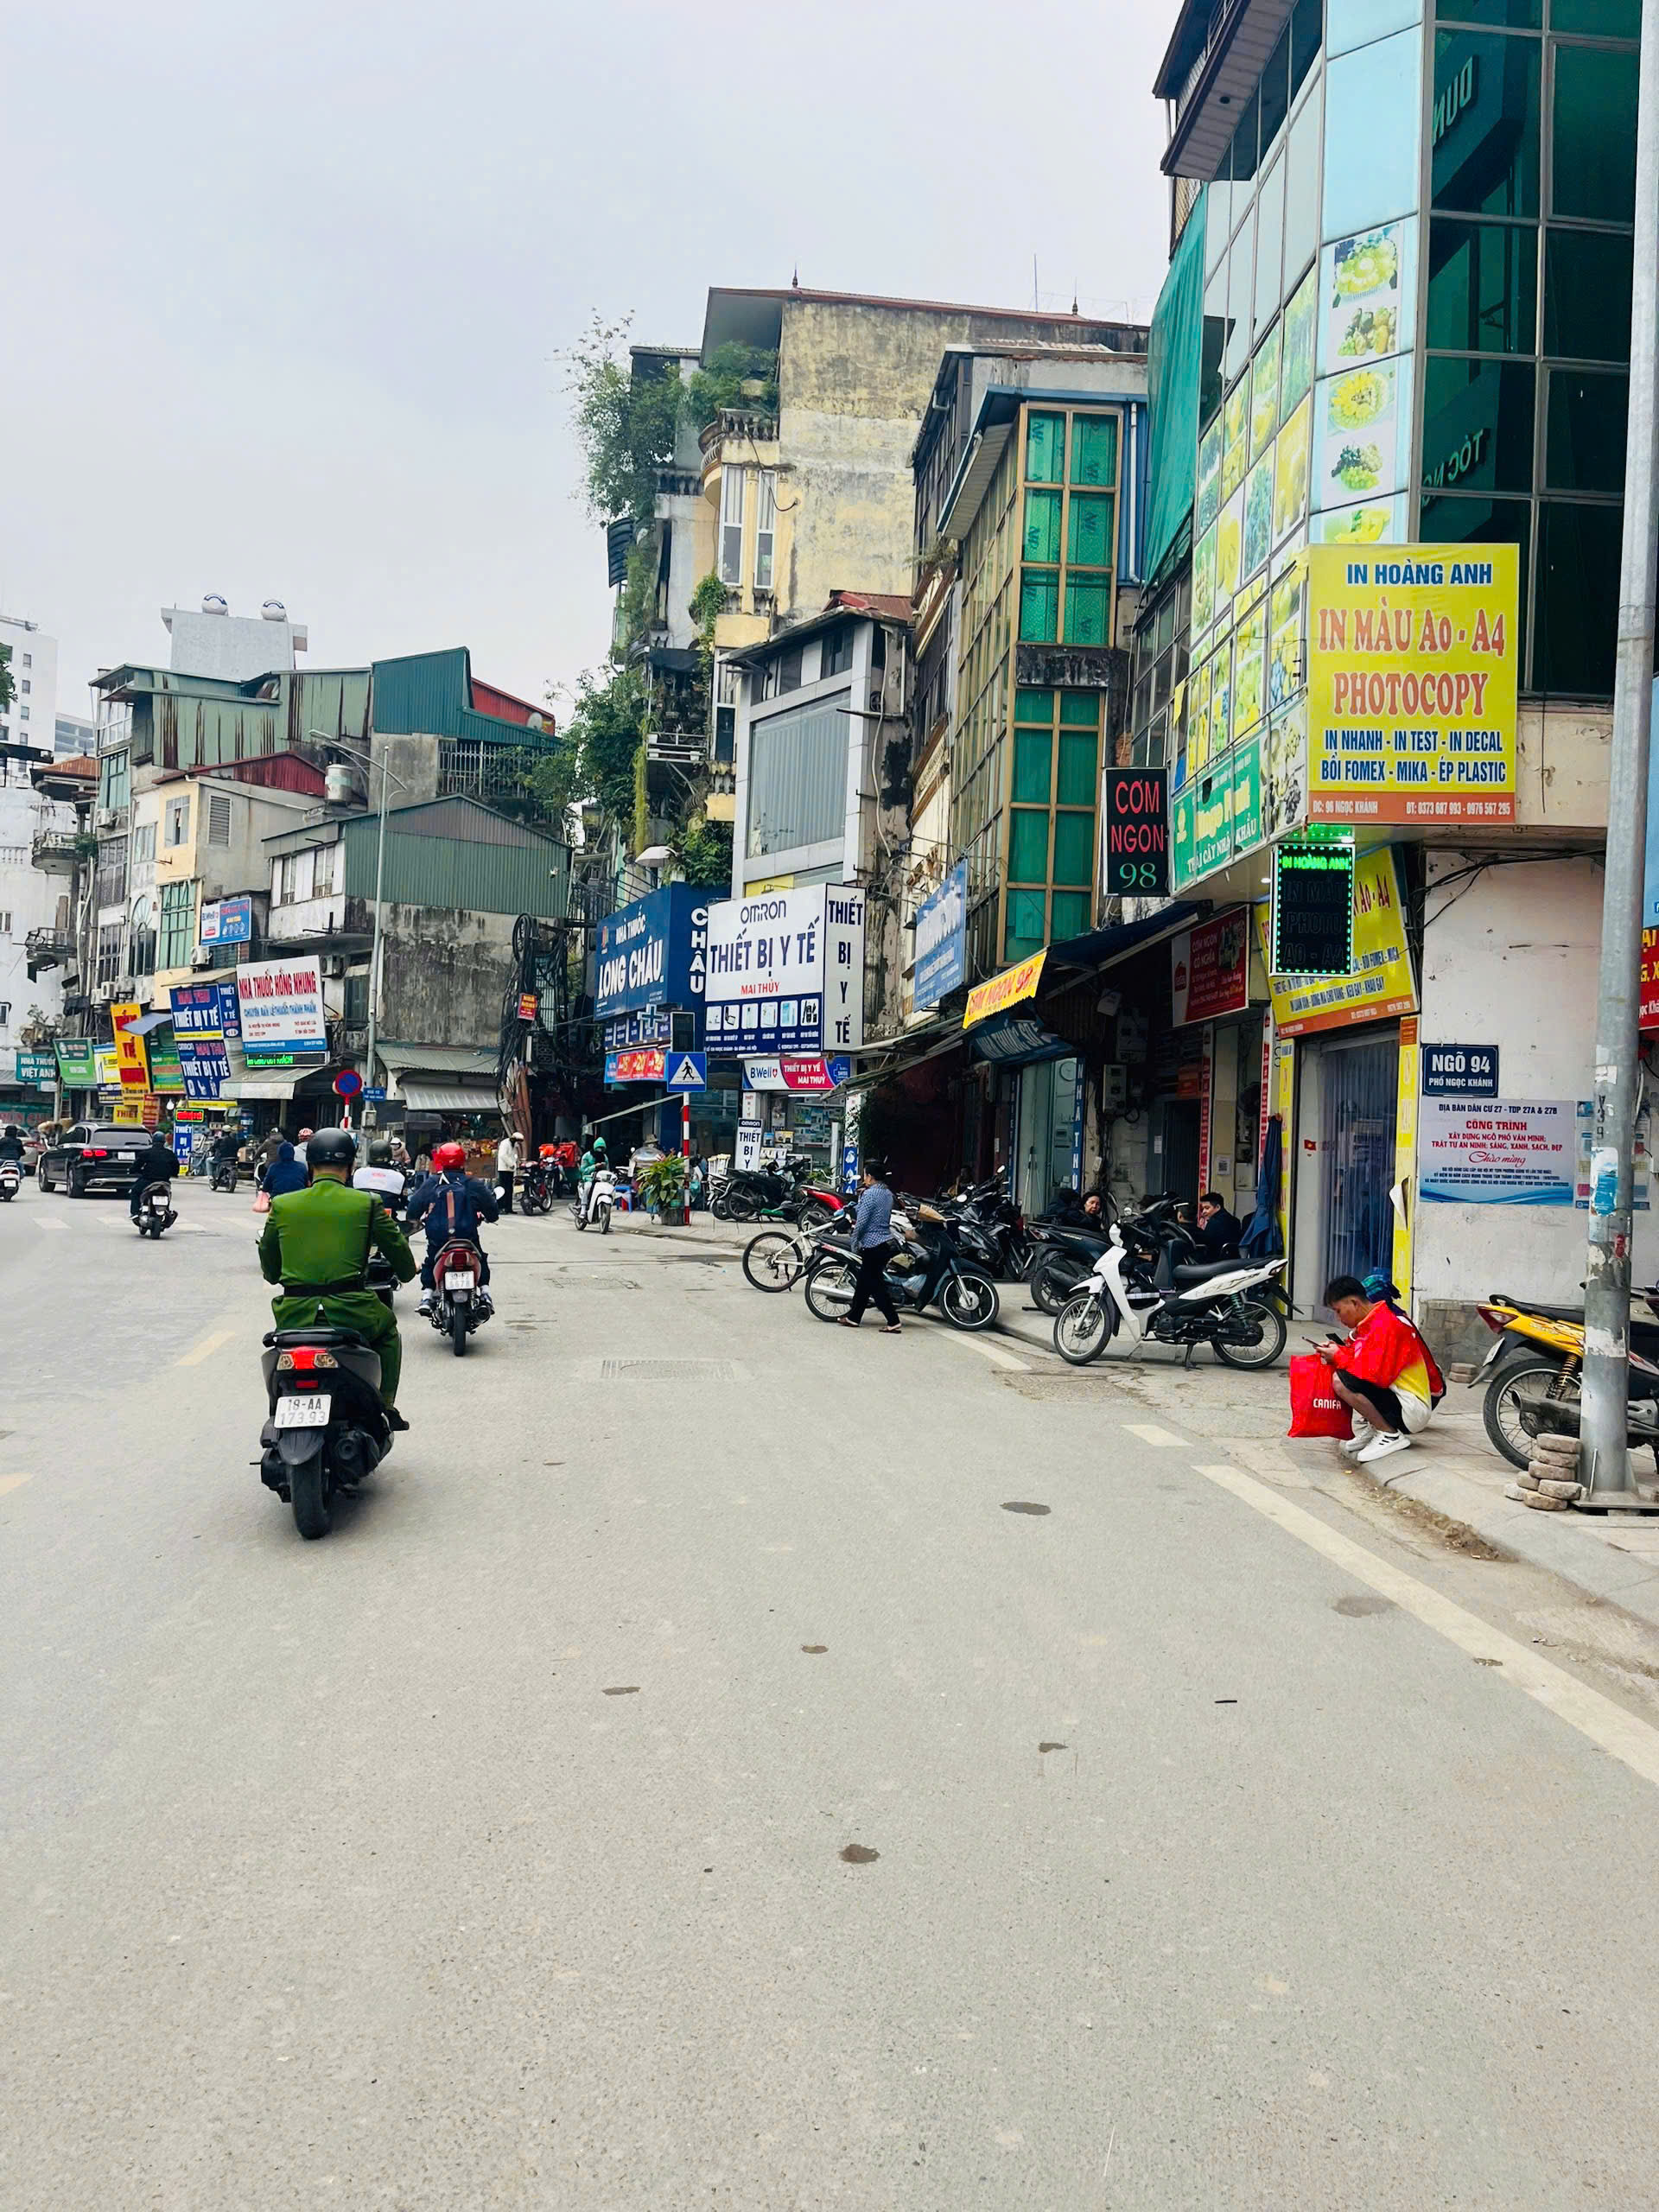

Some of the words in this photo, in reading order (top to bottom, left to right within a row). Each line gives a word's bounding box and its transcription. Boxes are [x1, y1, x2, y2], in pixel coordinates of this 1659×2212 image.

[1347, 563, 1368, 584] IN
[1375, 559, 1443, 584] HOÀNG
[1450, 563, 1492, 584] ANH
[1319, 608, 1347, 651] IN
[1354, 596, 1412, 652] MÀU
[1471, 608, 1504, 657] A4
[1333, 672, 1489, 716] PHOTOCOPY
[1325, 729, 1338, 750] IN
[1341, 730, 1382, 751] NHANH
[1394, 731, 1407, 751] IN
[1410, 731, 1439, 752] TEST
[1449, 731, 1462, 752] IN
[1465, 731, 1503, 752] DECAL
[1344, 760, 1386, 782] FOMEX
[1396, 761, 1427, 782] MIKA
[1439, 756, 1454, 782] ÉP
[1458, 761, 1506, 783] PLASTIC
[1115, 779, 1160, 815] CƠM
[1355, 798, 1378, 814] KHÁNH
[1110, 823, 1165, 853] NGON
[1119, 862, 1157, 889] 98
[828, 895, 863, 926] THIẾT
[690, 907, 709, 994] CHÂU
[710, 927, 752, 974] THIẾT
[757, 938, 773, 977] BỊ
[779, 935, 791, 966] Y
[797, 915, 820, 964] TẾ
[838, 942, 851, 969] BỊ
[238, 973, 252, 1000] NHÀ
[253, 969, 274, 997] THUỐC
[293, 970, 317, 995] NHUNG
[598, 954, 626, 1000] LONG
[741, 983, 756, 995] MAI
[840, 982, 848, 1003] Y
[173, 1006, 193, 1028] THIẾT
[202, 1009, 207, 1027] Y
[208, 1004, 219, 1027] TẾ
[835, 1014, 851, 1044] TẾ
[181, 1056, 201, 1077] THIẾT
[211, 1061, 218, 1077] Y
[218, 1055, 230, 1077] TẾ
[1432, 1051, 1465, 1072] NGÕ
[1471, 1055, 1491, 1073] 94
[798, 1076, 809, 1084] MAI
[1428, 1075, 1445, 1086] PHỐ
[1446, 1077, 1466, 1089] NGỌC
[1467, 1077, 1493, 1087] KHÁNH
[1452, 1103, 1465, 1112] BÀN
[1465, 1118, 1493, 1130] CÔNG
[1495, 1120, 1528, 1131] TRÌNH
[745, 1160, 750, 1168] Y
[1469, 1151, 1500, 1163] Chào
[1313, 1398, 1341, 1409] CANIFA
